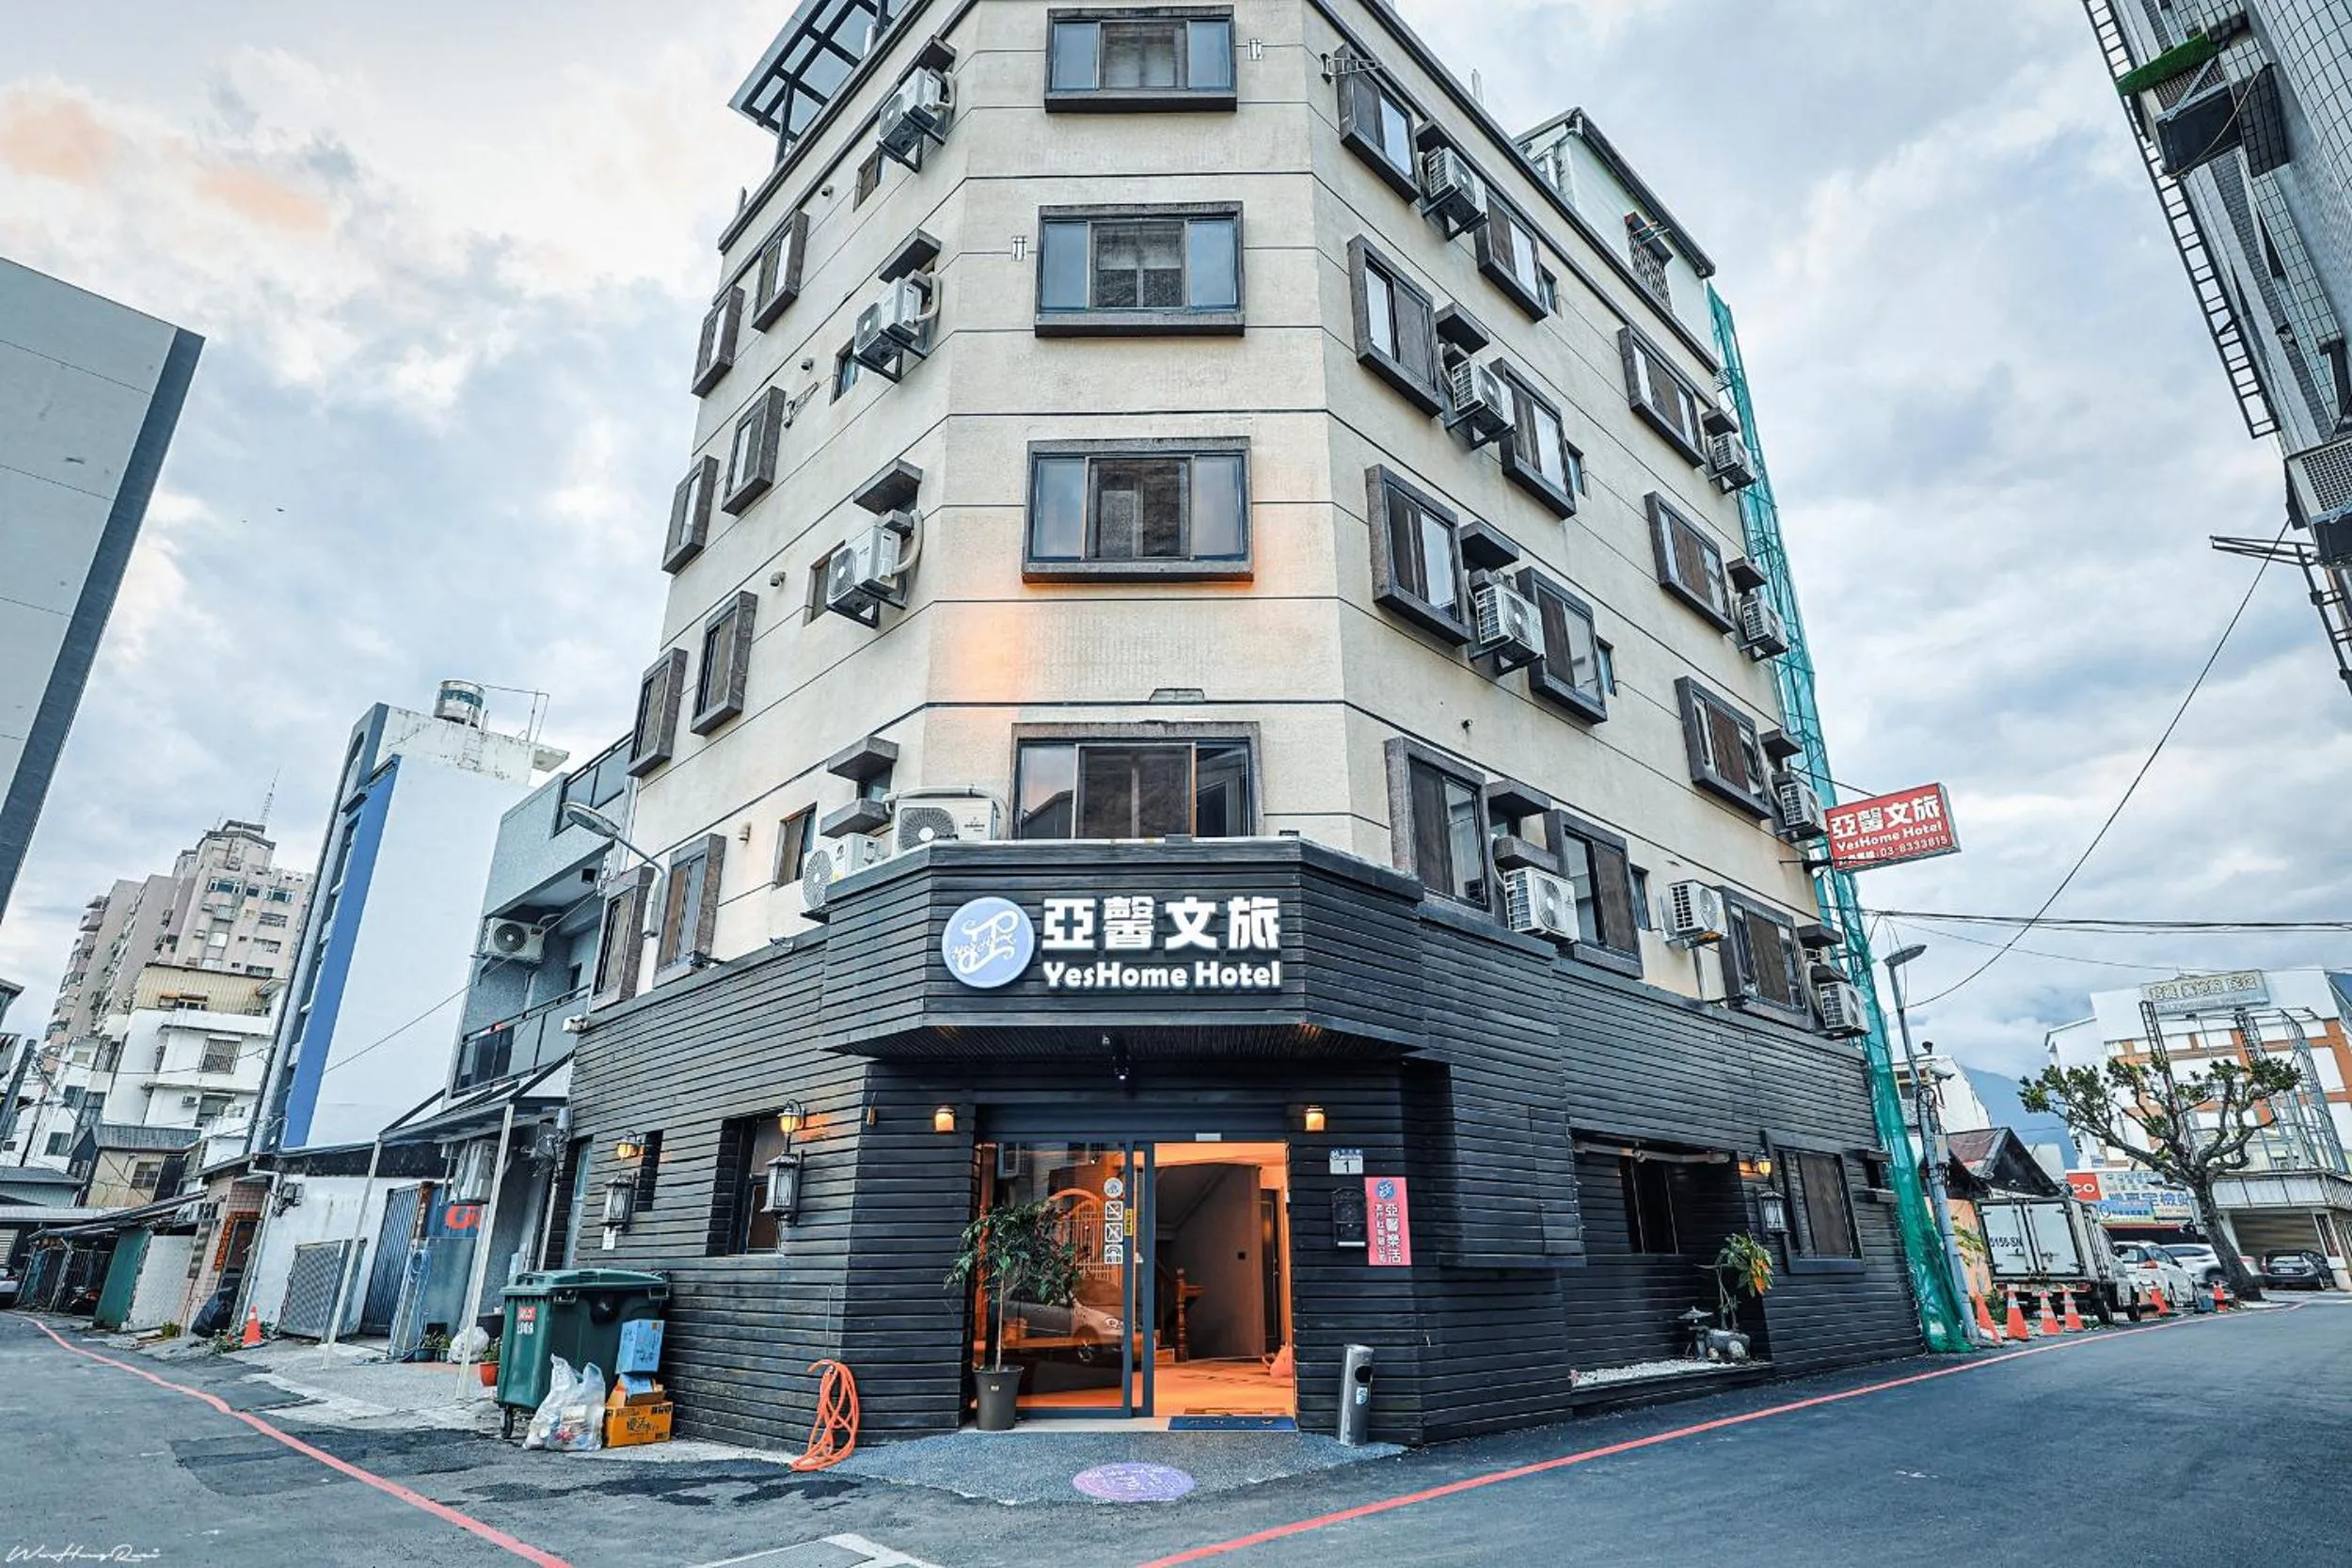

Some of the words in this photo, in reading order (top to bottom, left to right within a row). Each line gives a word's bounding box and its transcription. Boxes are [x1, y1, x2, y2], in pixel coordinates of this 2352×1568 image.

[1831, 795, 1940, 839] 亞馨文旅
[1836, 832, 1900, 851] YesHome
[1903, 821, 1943, 838] Hotel
[1041, 896, 1280, 950] 亞馨文旅
[1042, 961, 1187, 989] YesHome
[1195, 960, 1280, 988] Hotel
